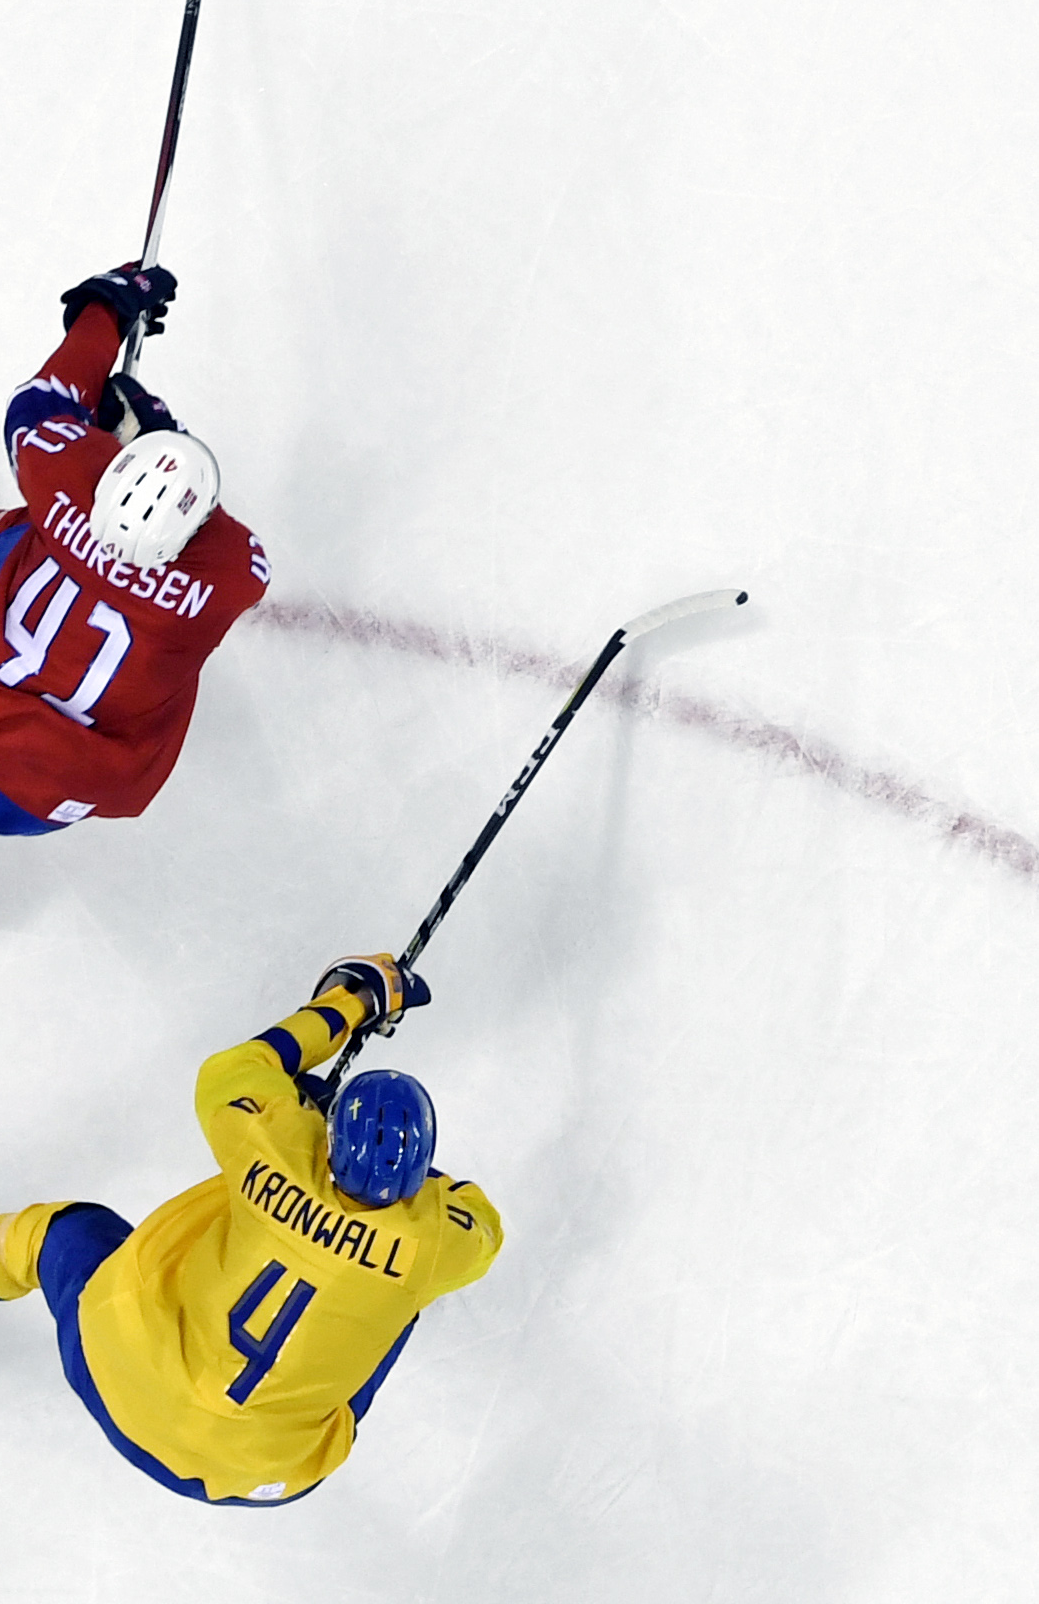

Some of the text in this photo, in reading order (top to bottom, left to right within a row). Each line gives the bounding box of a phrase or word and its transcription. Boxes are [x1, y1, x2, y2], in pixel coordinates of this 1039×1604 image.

[42, 490, 214, 619] THORESEN
[240, 1159, 403, 1279] KRONWALL
[224, 1258, 318, 1407] 4
